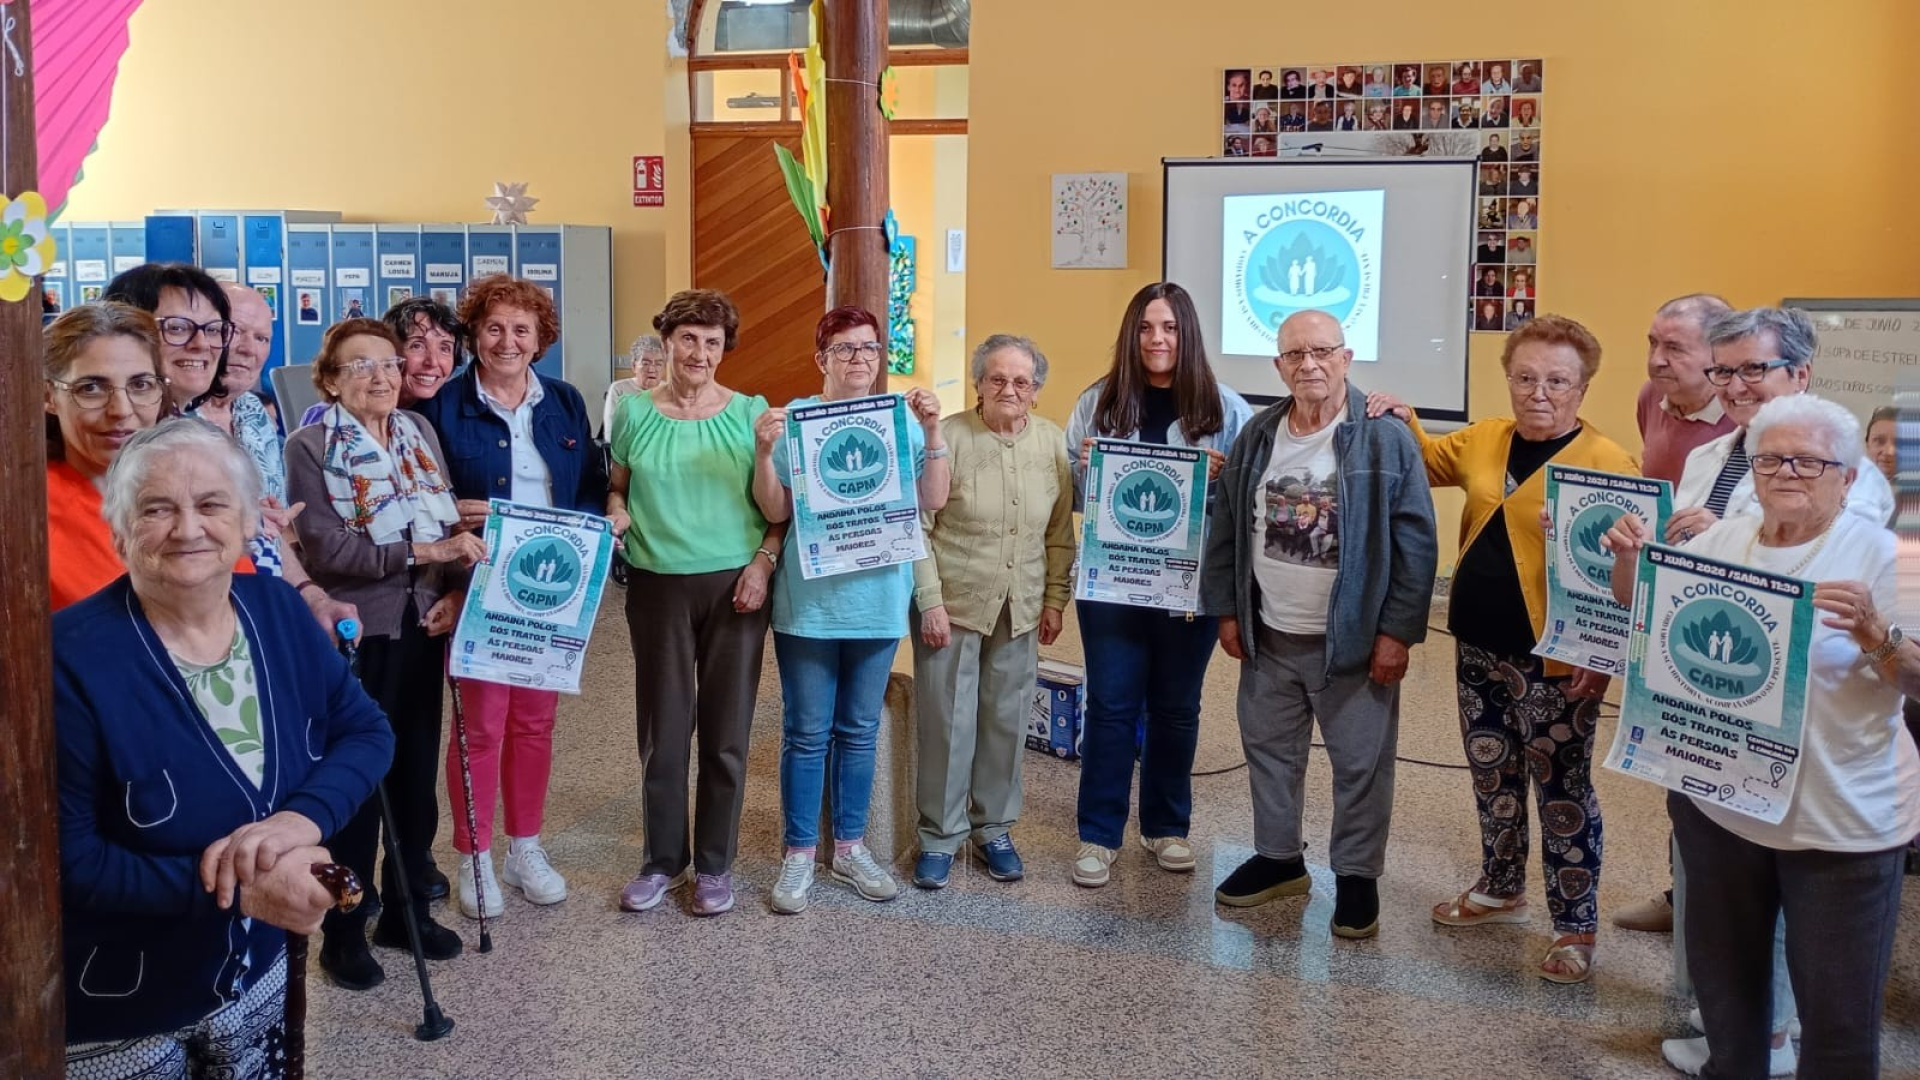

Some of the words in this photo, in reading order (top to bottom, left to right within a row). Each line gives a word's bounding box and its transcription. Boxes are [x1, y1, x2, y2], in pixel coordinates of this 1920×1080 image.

[1243, 230, 1258, 244] A
[1256, 199, 1366, 243] CONCORDIA
[814, 437, 823, 446] A
[822, 416, 887, 438] CONCORDIA
[838, 478, 876, 494] CAPM
[1114, 471, 1123, 481] A
[1122, 460, 1184, 487] CONCORDIA
[1569, 505, 1580, 517] A
[1126, 520, 1164, 533] CAPM
[515, 534, 525, 544] A
[524, 525, 589, 558] CONCORDIA
[1650, 551, 1663, 561] 15
[1664, 554, 1695, 569] XUÑO
[517, 589, 558, 606] CAPM
[1671, 594, 1684, 608] A
[1683, 582, 1779, 634] CONCORDIA
[1688, 666, 1745, 695] CAPM
[1652, 693, 1706, 718] ANDAINA
[1710, 711, 1753, 731] POLOS
[1690, 719, 1739, 743] TRATOS
[1665, 744, 1723, 771] MAIORES
[1679, 732, 1738, 759] PERSOAS
